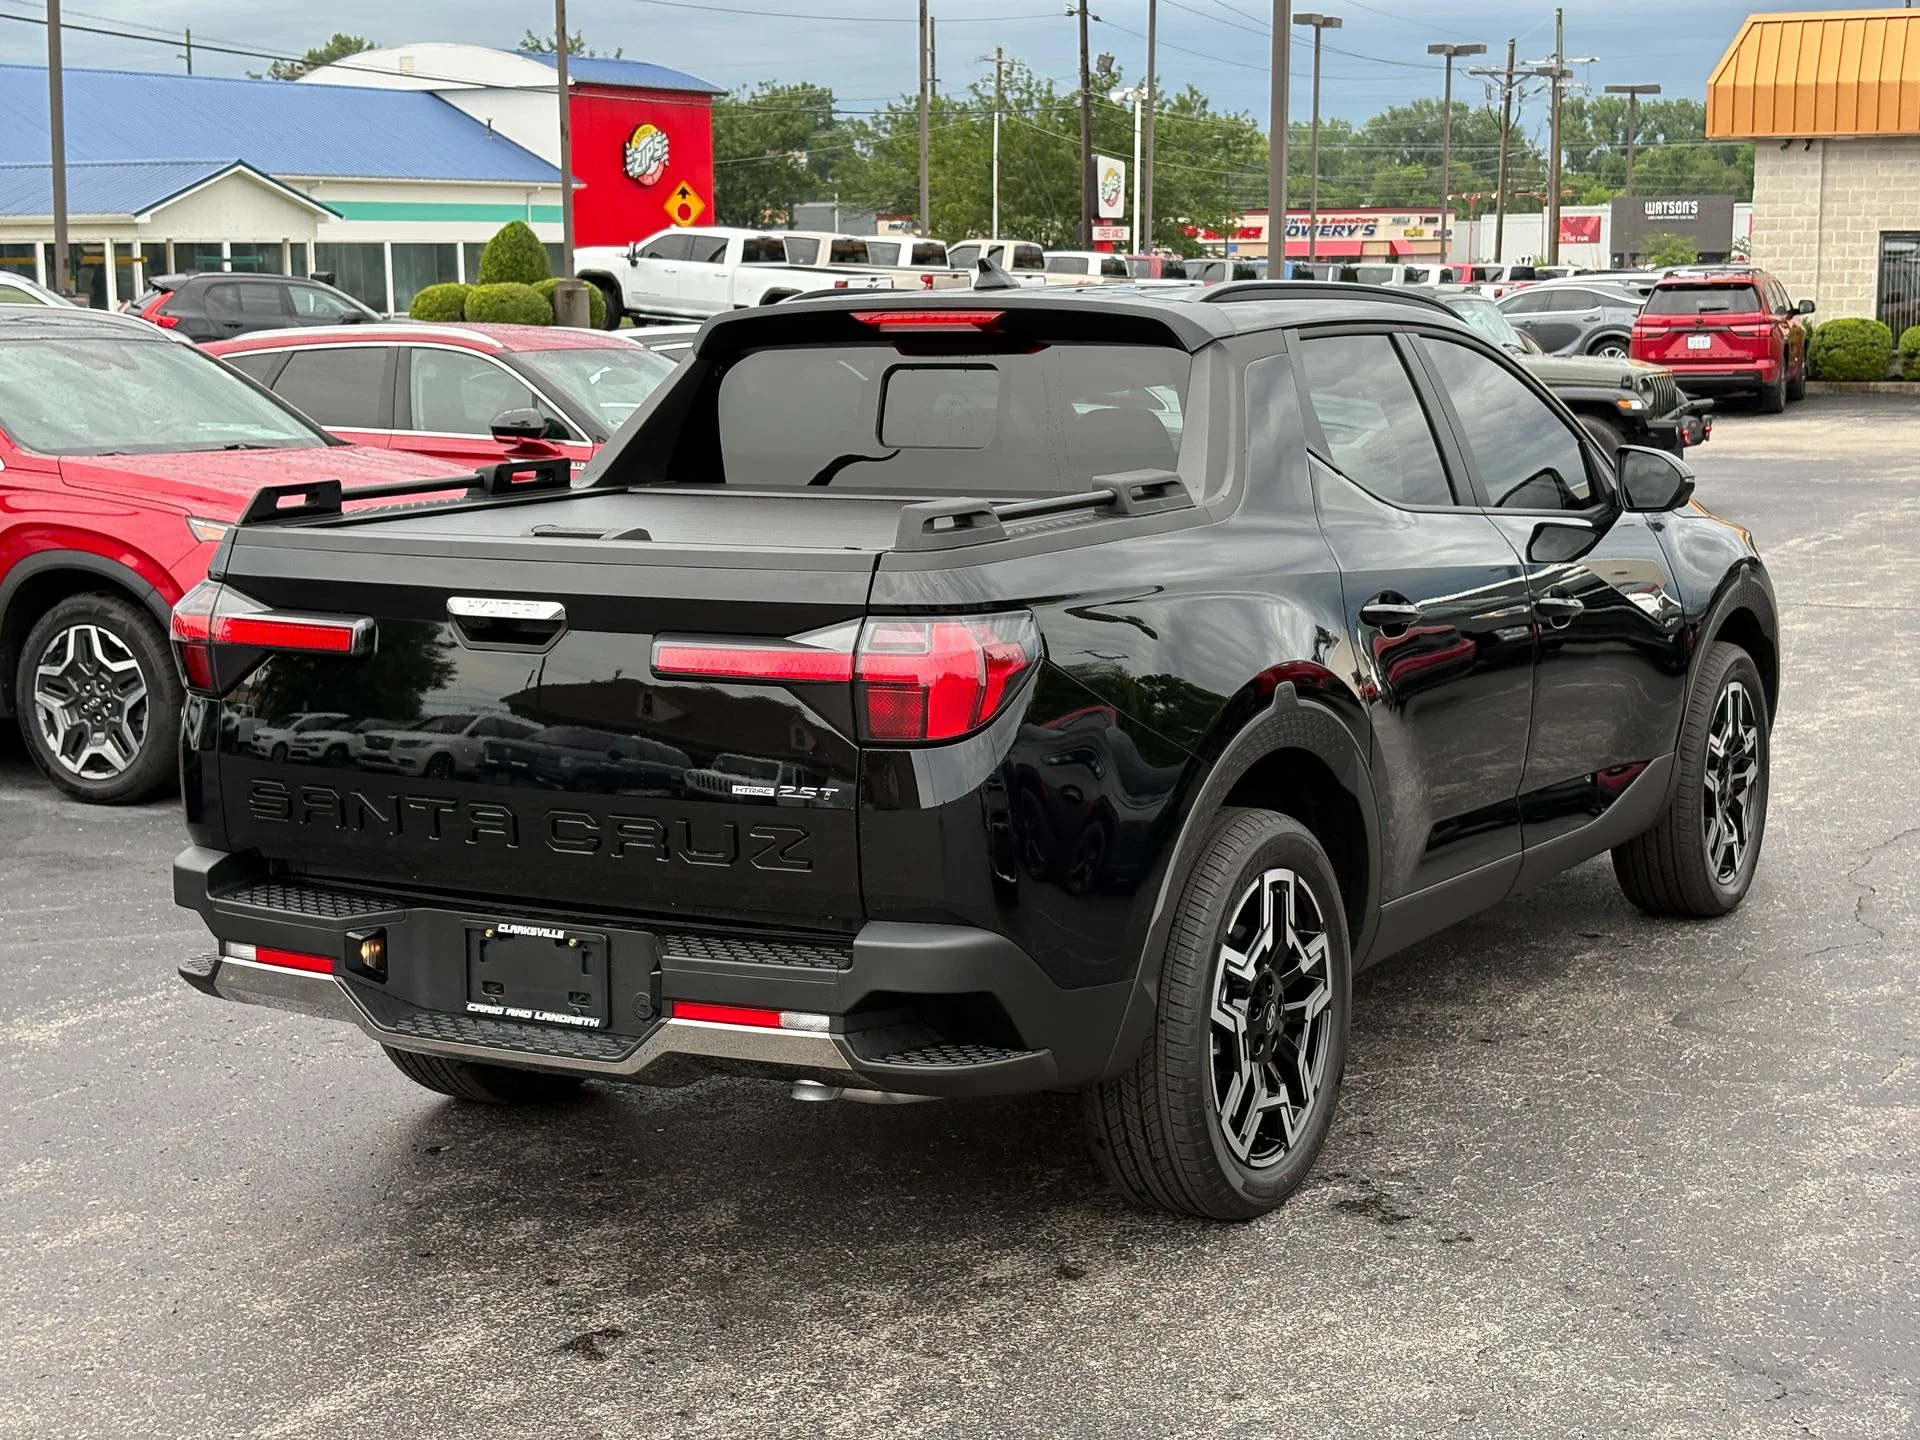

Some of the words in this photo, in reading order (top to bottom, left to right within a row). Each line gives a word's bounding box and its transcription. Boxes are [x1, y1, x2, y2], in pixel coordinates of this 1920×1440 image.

[633, 135, 664, 173] ZIPS
[1644, 200, 1698, 214] WATSON'S
[1284, 224, 1377, 237] OWERY'S
[466, 600, 540, 617] HYUNDAI
[733, 786, 774, 796] HTRAC
[249, 777, 520, 849] SANTA
[543, 810, 814, 873] CRUZ
[497, 923, 565, 940] CLARKSVILLE
[505, 1008, 533, 1019] AND
[534, 1011, 601, 1028] LANDRETH
